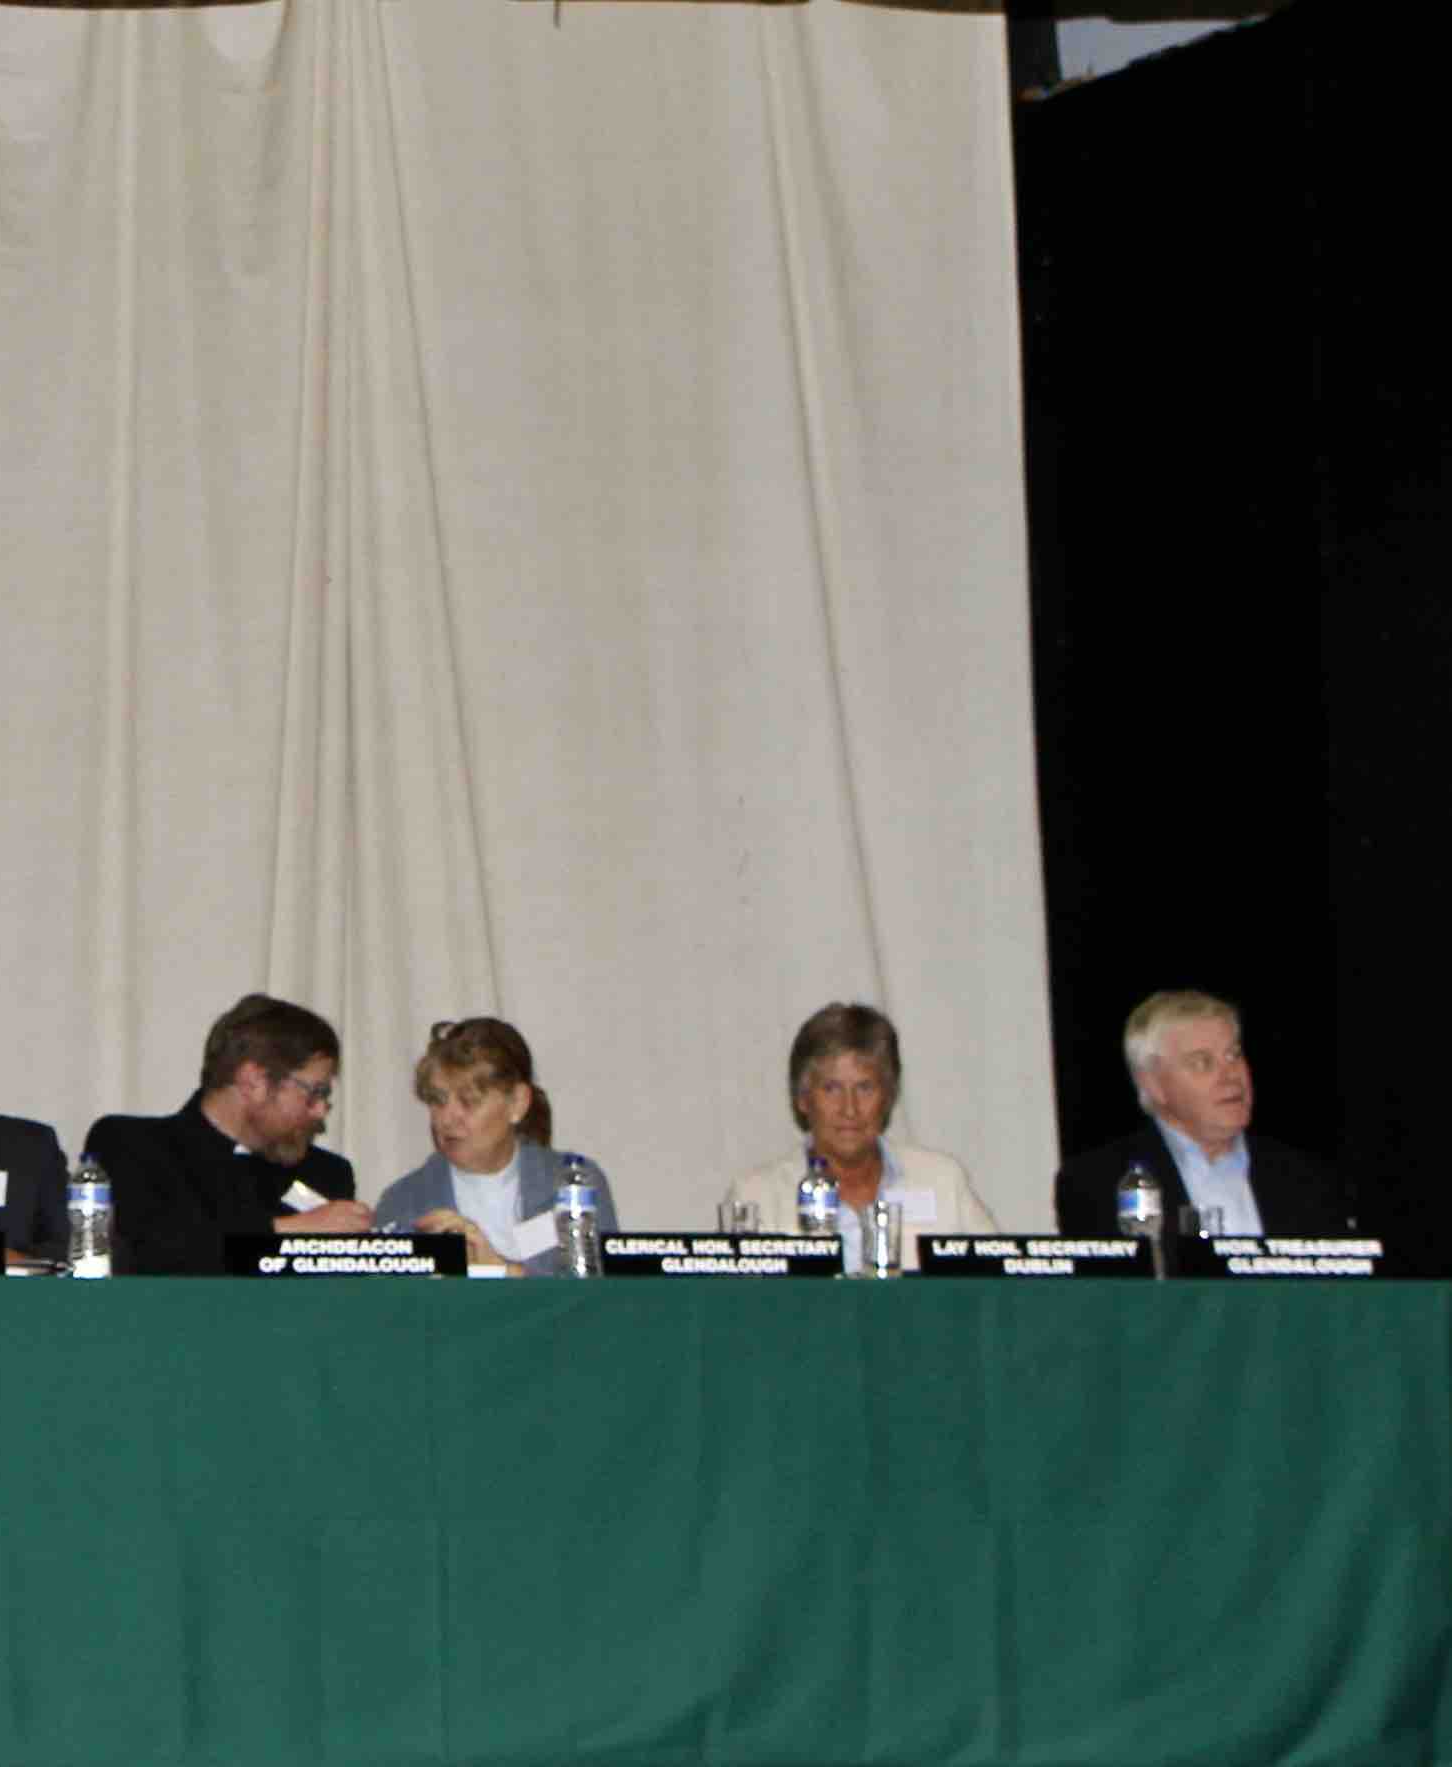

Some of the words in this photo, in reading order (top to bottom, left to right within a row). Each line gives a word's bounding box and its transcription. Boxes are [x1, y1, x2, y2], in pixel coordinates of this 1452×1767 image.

[279, 1238, 414, 1256] ARCHDEACON
[604, 1238, 689, 1256] CLERICAL
[691, 1239, 735, 1256] HON.
[738, 1238, 841, 1257] SECRETARY
[931, 1239, 969, 1257] LAY
[973, 1239, 1022, 1257] HON.
[1026, 1239, 1138, 1257] SECRETARY
[1213, 1238, 1263, 1256] HON.
[1264, 1238, 1383, 1257] TREASURER
[258, 1256, 288, 1273] OF
[292, 1256, 436, 1274] GLENDALOUGH
[661, 1256, 789, 1274] GLENDALOUGH
[1003, 1257, 1074, 1275] DUBLIN
[1227, 1256, 1374, 1275] GLENDALOUGH
